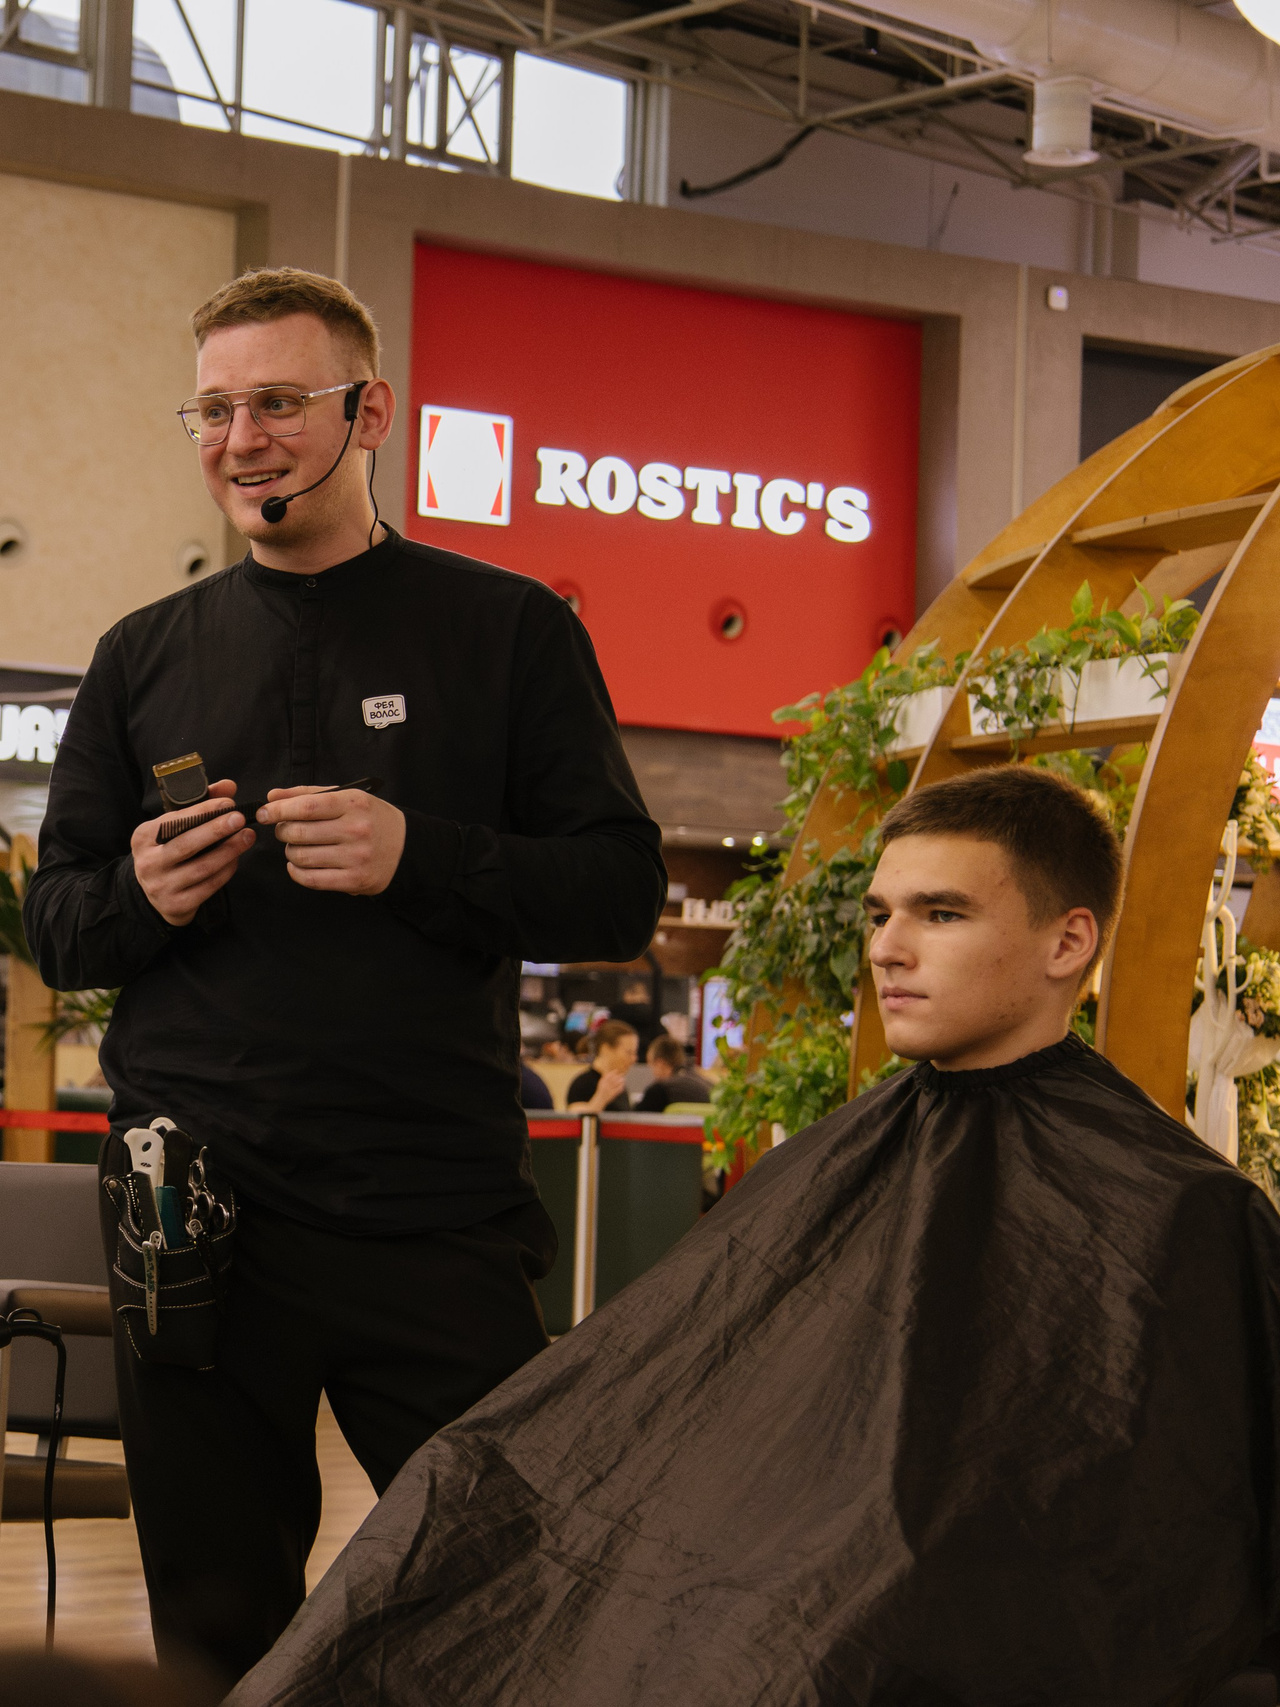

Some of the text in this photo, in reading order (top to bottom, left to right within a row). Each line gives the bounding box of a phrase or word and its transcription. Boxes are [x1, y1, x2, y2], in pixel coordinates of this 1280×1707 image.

[535, 446, 872, 543] ROSTIC'S
[374, 700, 395, 710] ФЕЯ
[369, 708, 401, 720] ВОЛОС
